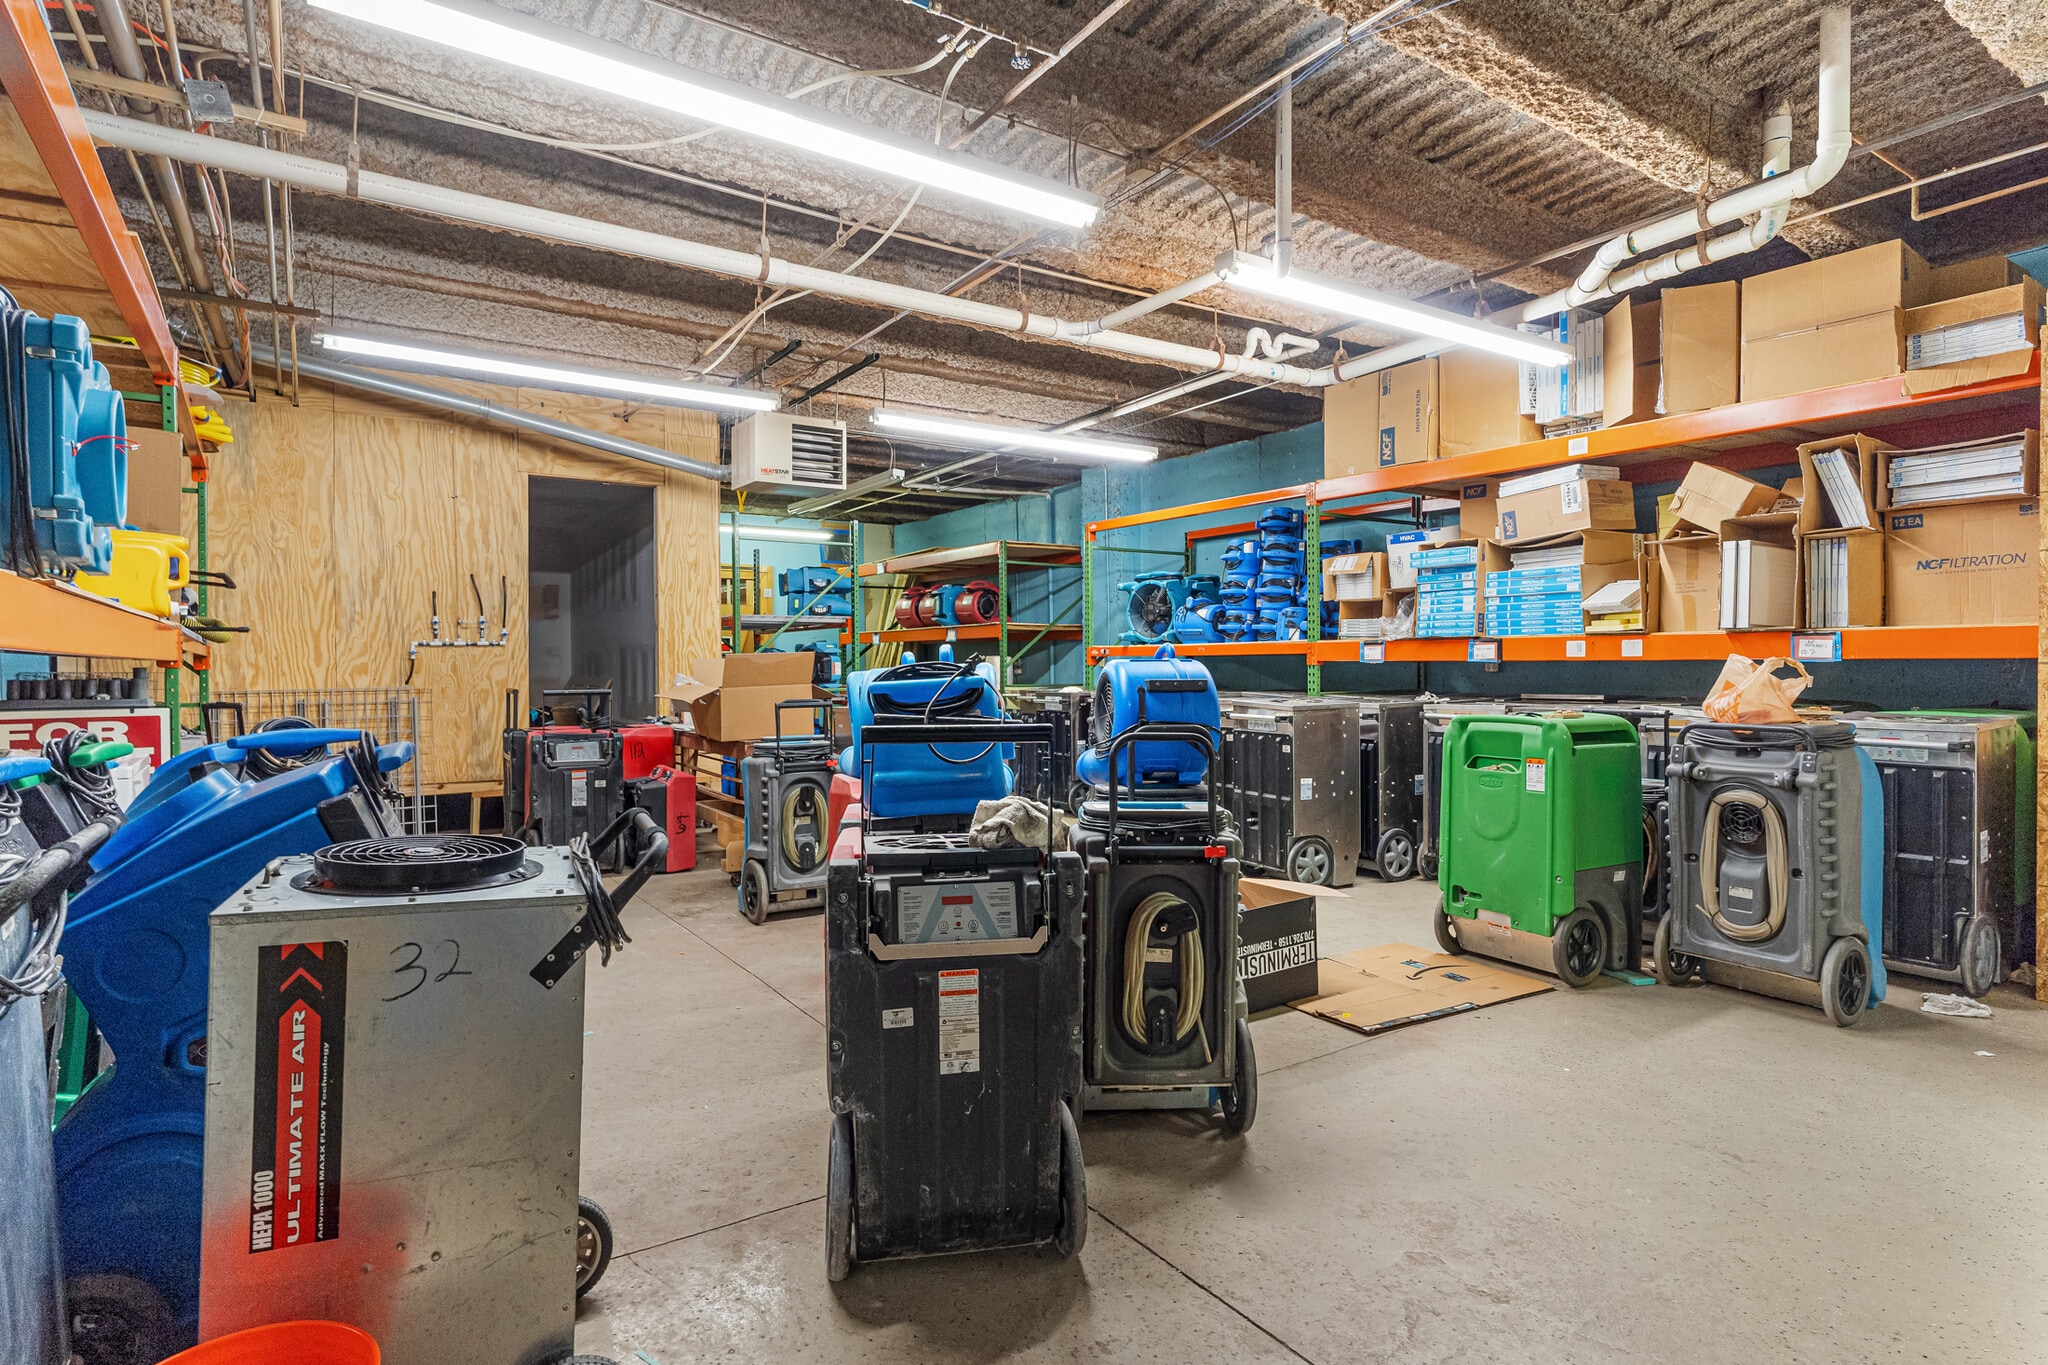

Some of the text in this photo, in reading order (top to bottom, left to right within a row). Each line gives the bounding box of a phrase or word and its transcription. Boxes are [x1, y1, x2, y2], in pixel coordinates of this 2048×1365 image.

[1382, 434, 1392, 460] NCF
[1466, 487, 1484, 496] NCF
[1894, 517, 1922, 527] 12 EA
[1916, 553, 2027, 570] NCFILTRATION
[0, 720, 129, 750] FOR
[1278, 930, 1314, 946] 770.926.1158
[382, 940, 472, 1002] 32
[287, 1009, 306, 1244] ULTIMATE AIR
[317, 1041, 329, 1239] Advanced MAXX FLOW Technology
[252, 1170, 274, 1250] HEPA 1000
